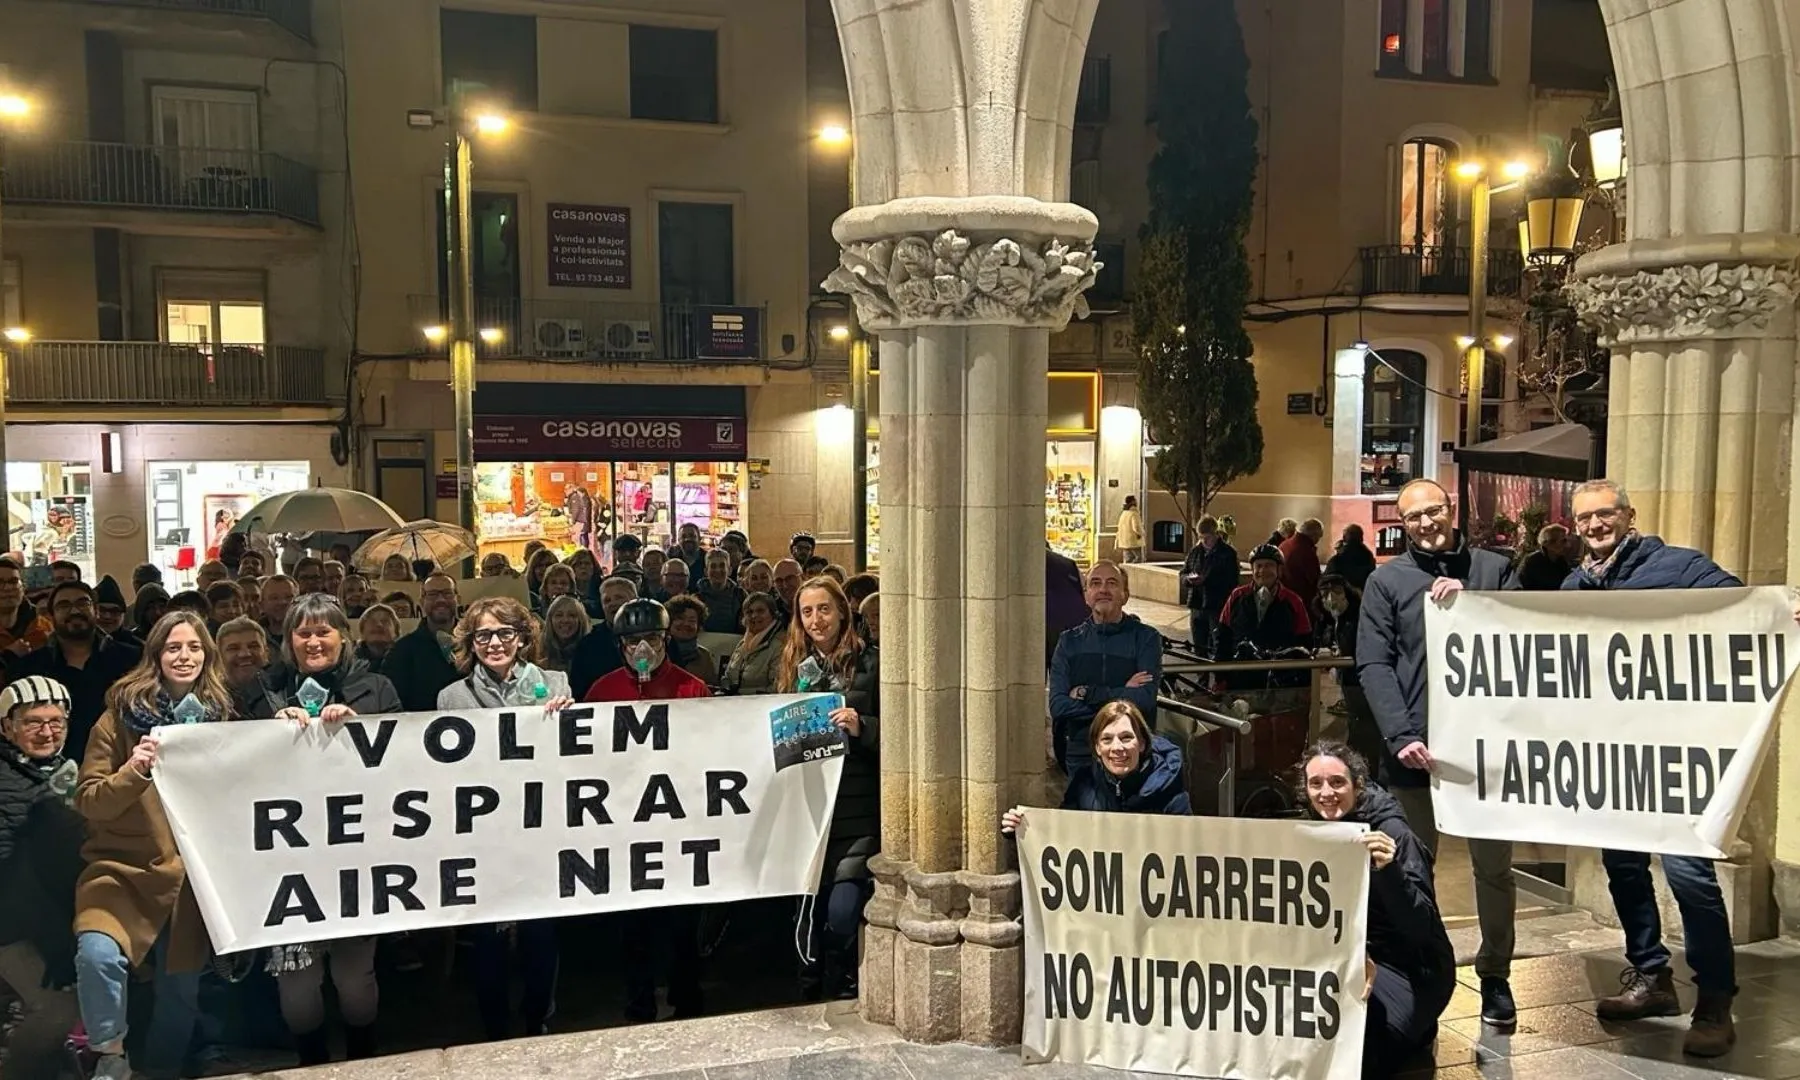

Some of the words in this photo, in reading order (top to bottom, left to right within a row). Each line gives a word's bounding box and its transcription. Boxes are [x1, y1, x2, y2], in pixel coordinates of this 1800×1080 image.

[553, 210, 626, 222] casanovas
[554, 234, 584, 243] Venda
[598, 237, 624, 247] Major
[561, 246, 626, 256] professionals
[542, 421, 682, 438] casanovas
[1445, 632, 1592, 699] SALVEM
[1607, 633, 1784, 702] GALILEU
[344, 704, 669, 768] VOLEM
[783, 705, 808, 721] AIRE
[1476, 738, 1487, 801] I
[253, 771, 751, 852] RESPIRAR
[263, 858, 477, 927] AIRE
[559, 838, 721, 899] NET
[1041, 845, 1124, 916] SOM
[1140, 852, 1343, 944] CARRERS,
[1043, 952, 1095, 1020] NO
[1106, 955, 1342, 1041] AUTOPISTES
